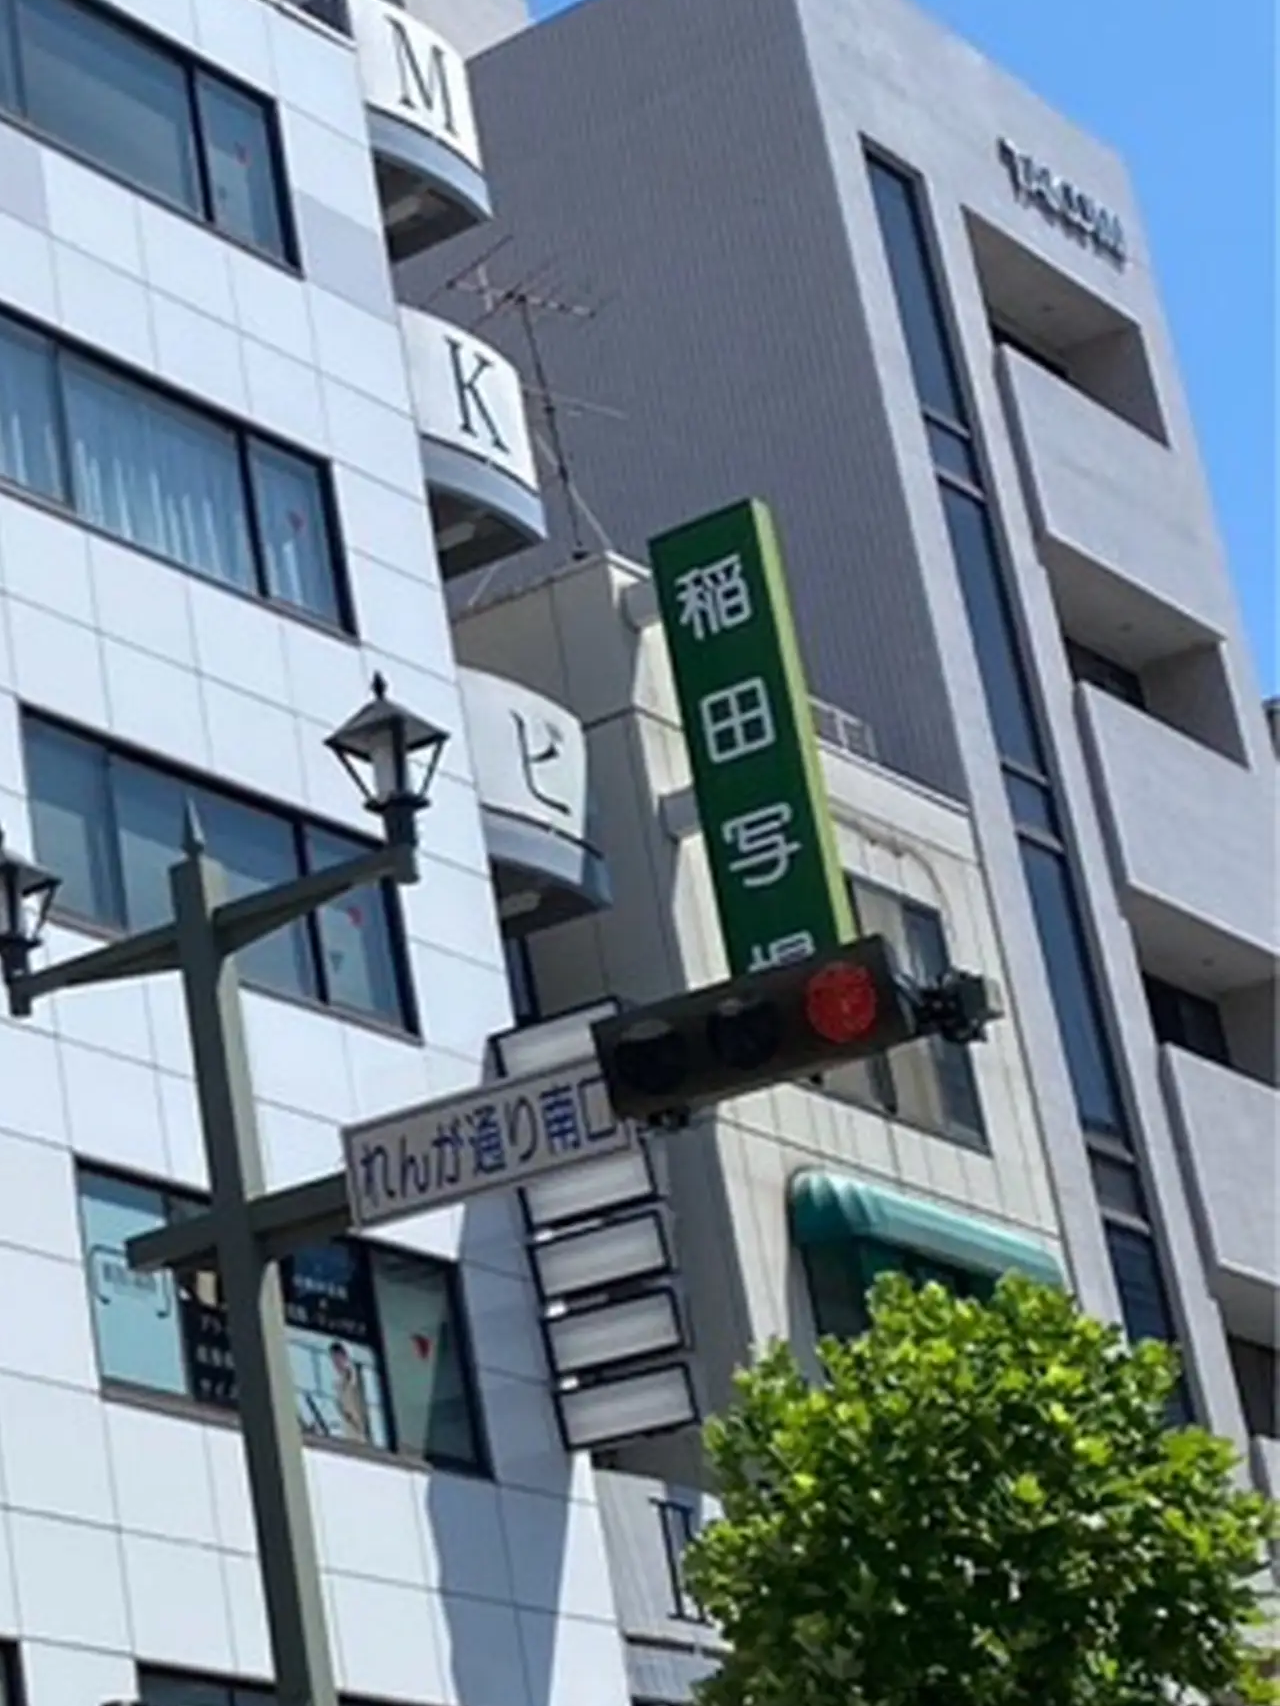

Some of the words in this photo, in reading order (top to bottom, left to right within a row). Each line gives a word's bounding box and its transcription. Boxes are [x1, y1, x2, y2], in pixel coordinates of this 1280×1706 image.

[389, 17, 459, 138] M
[444, 337, 511, 455] K
[512, 709, 570, 816] ビ
[360, 1076, 617, 1209] れんが通り南口
